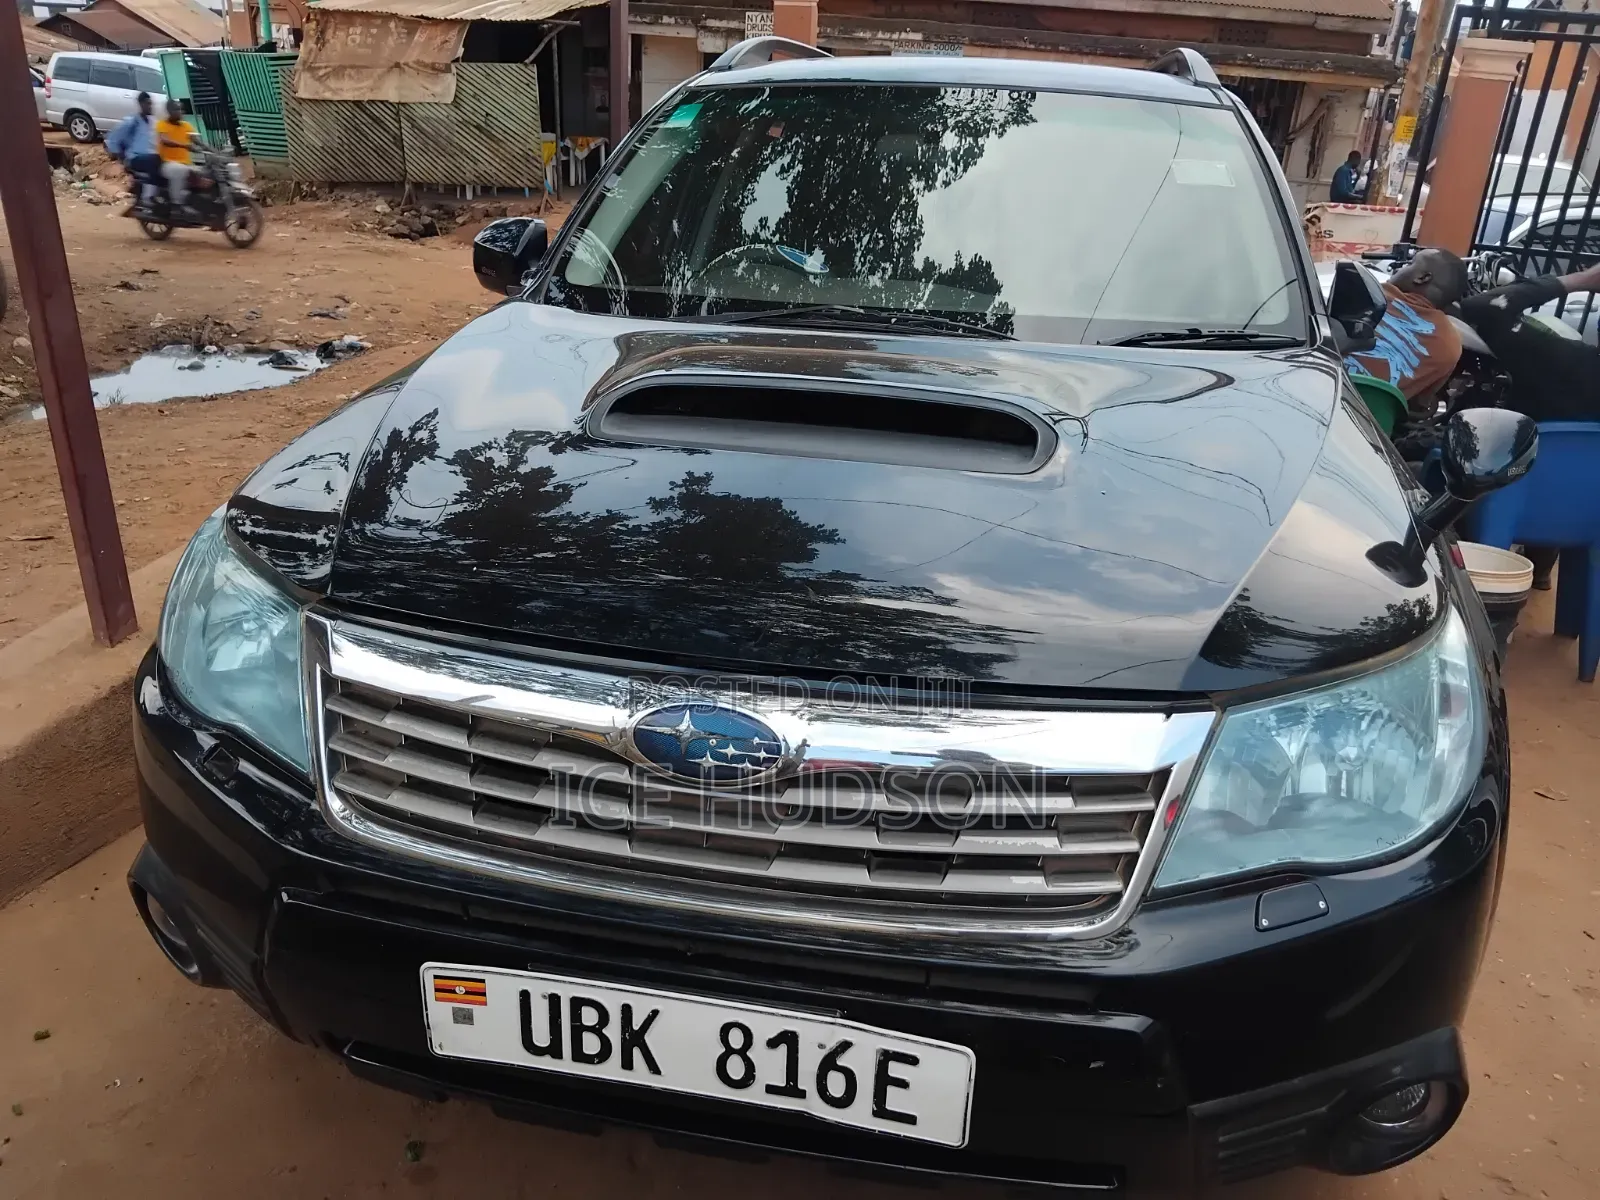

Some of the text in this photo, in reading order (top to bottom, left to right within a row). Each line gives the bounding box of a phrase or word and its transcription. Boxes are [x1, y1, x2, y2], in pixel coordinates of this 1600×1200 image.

[747, 14, 773, 23] NYAN
[746, 23, 774, 32] DRUGS
[893, 40, 931, 50] PARKING
[518, 988, 922, 1126] UBK 816E
